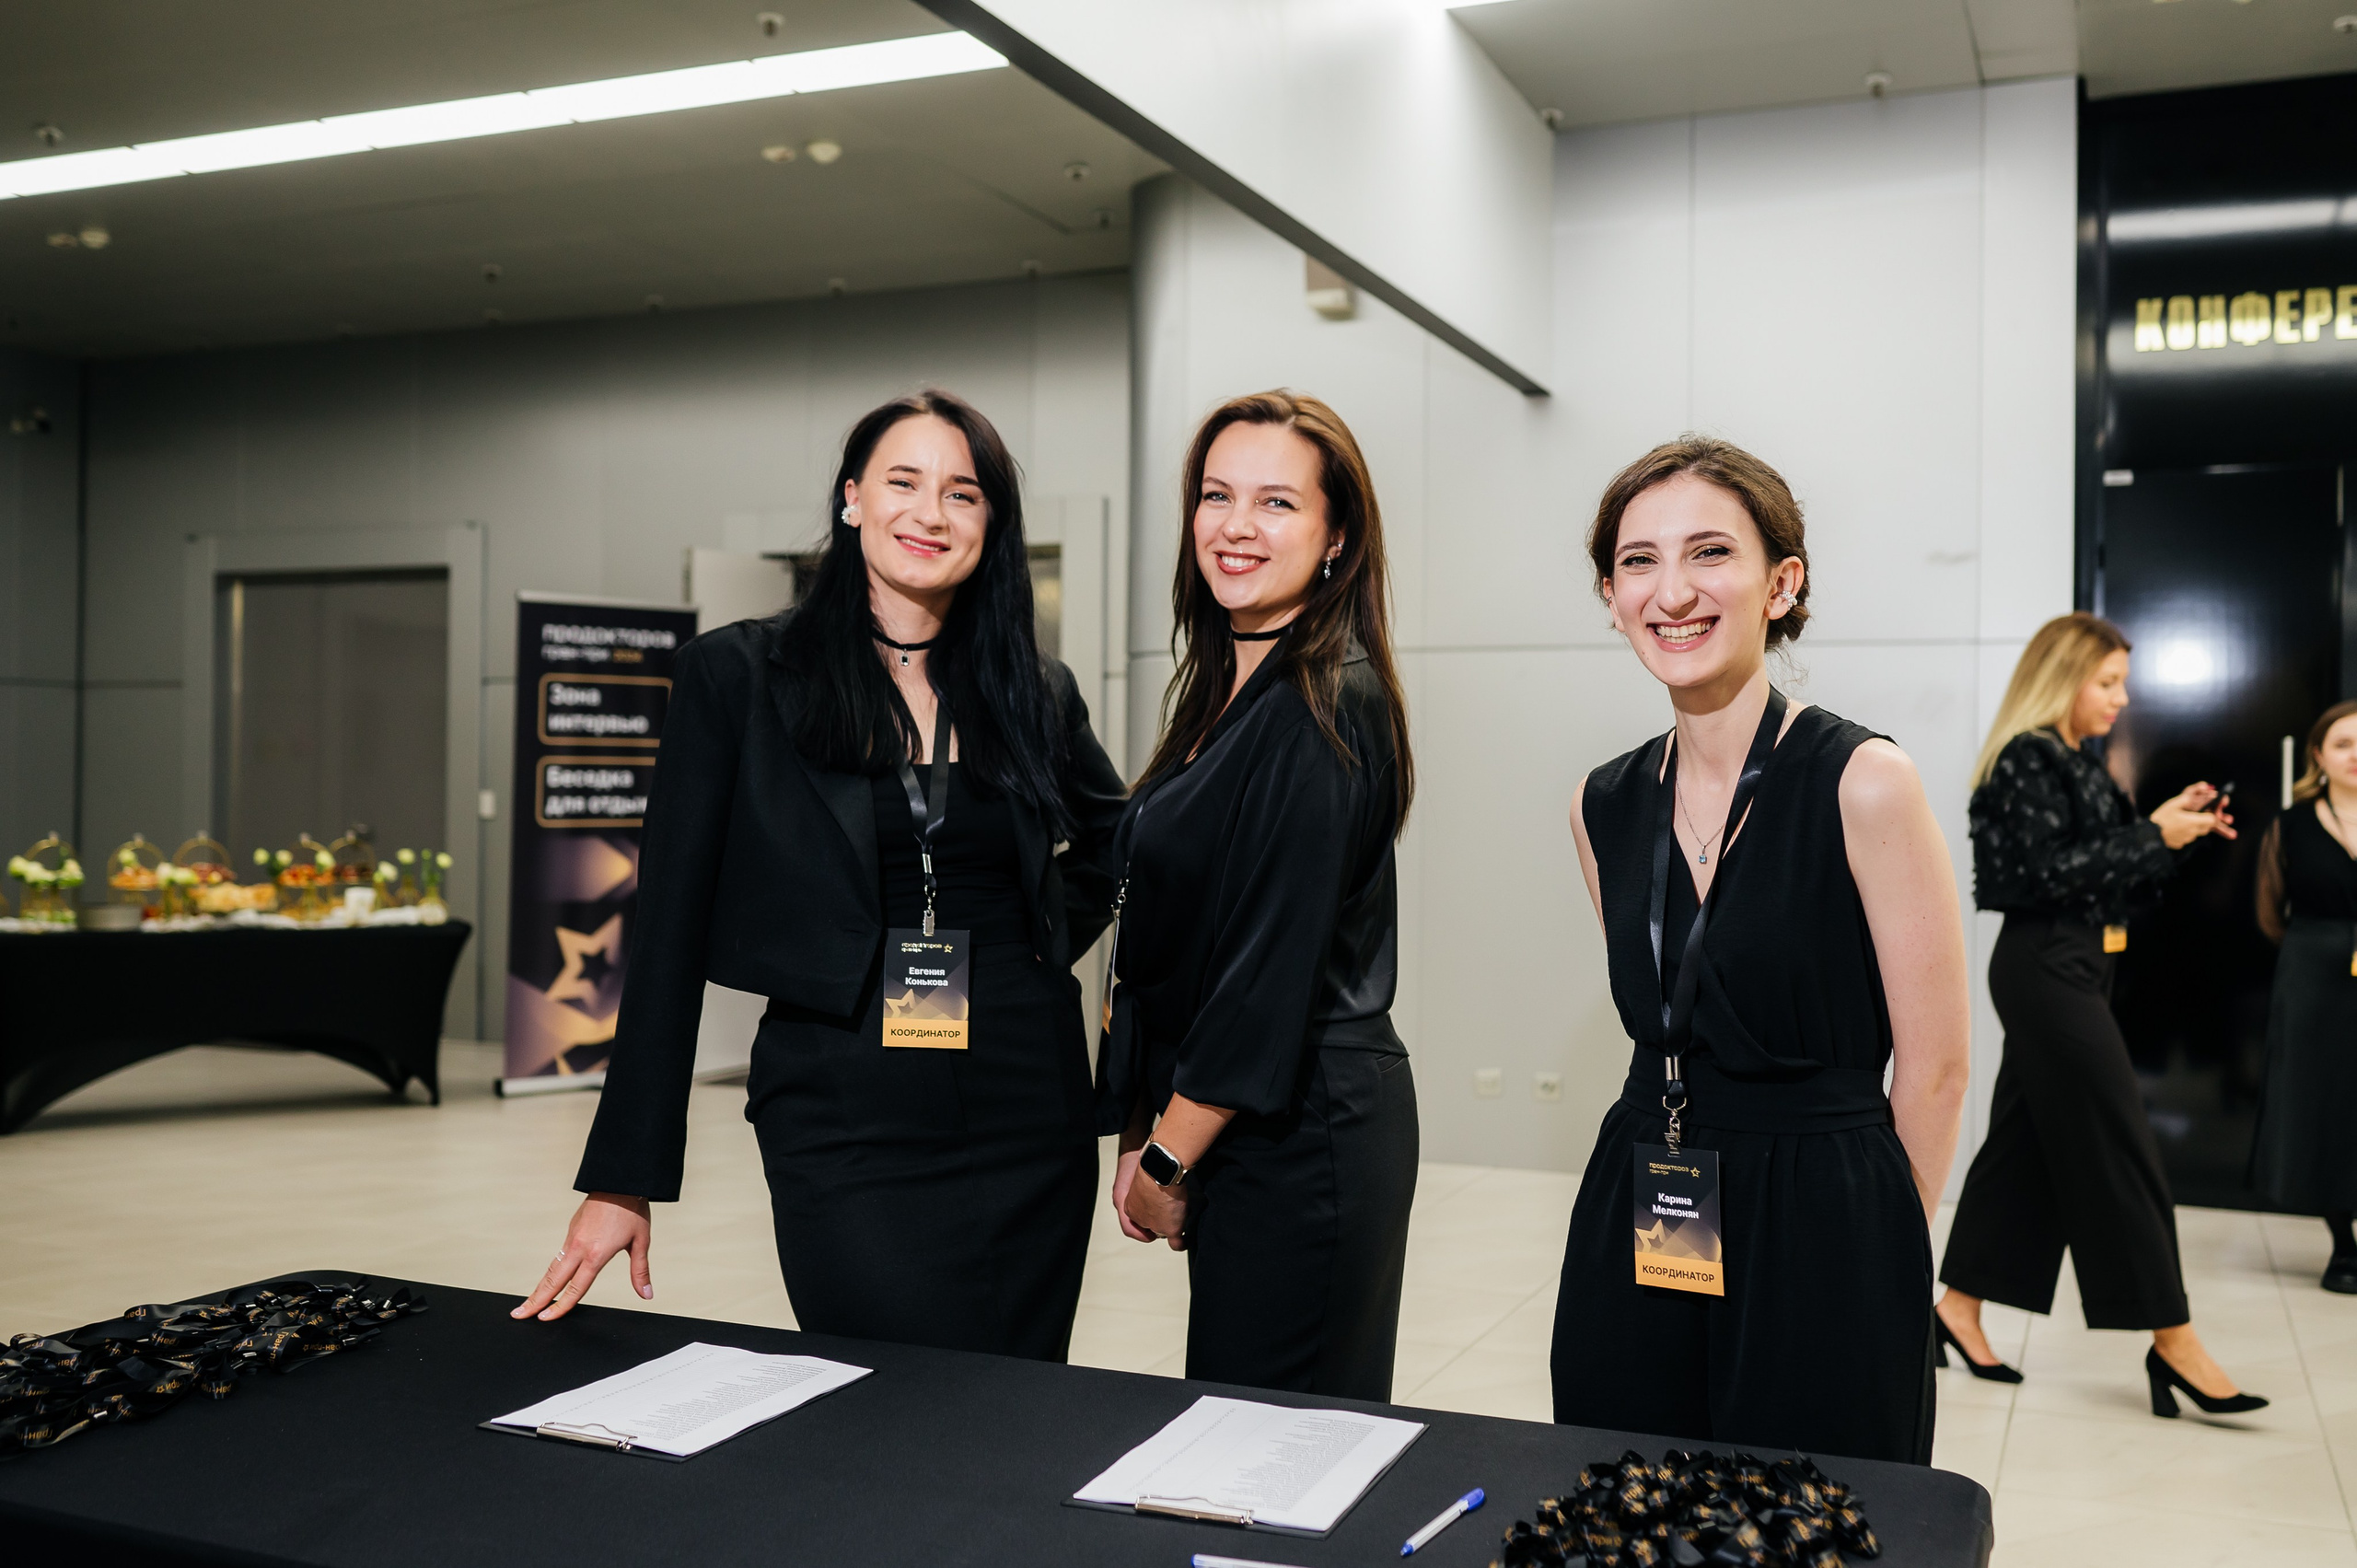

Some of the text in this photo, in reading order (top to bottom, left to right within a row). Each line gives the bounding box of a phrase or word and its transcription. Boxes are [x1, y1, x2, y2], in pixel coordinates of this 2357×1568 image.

[2134, 285, 2357, 353] КОНФЕРЕ
[549, 682, 601, 706] Зона
[548, 714, 649, 737] интервью
[546, 765, 634, 791] Беседка
[544, 796, 586, 818] для
[909, 967, 946, 976] Евгения
[905, 977, 949, 986] Конькова
[890, 1028, 961, 1039] КООРДИНАТОР
[1657, 1192, 1692, 1206] Карина
[1652, 1204, 1700, 1220] Мелконян
[1642, 1264, 1715, 1283] КООРДИНАТОР
